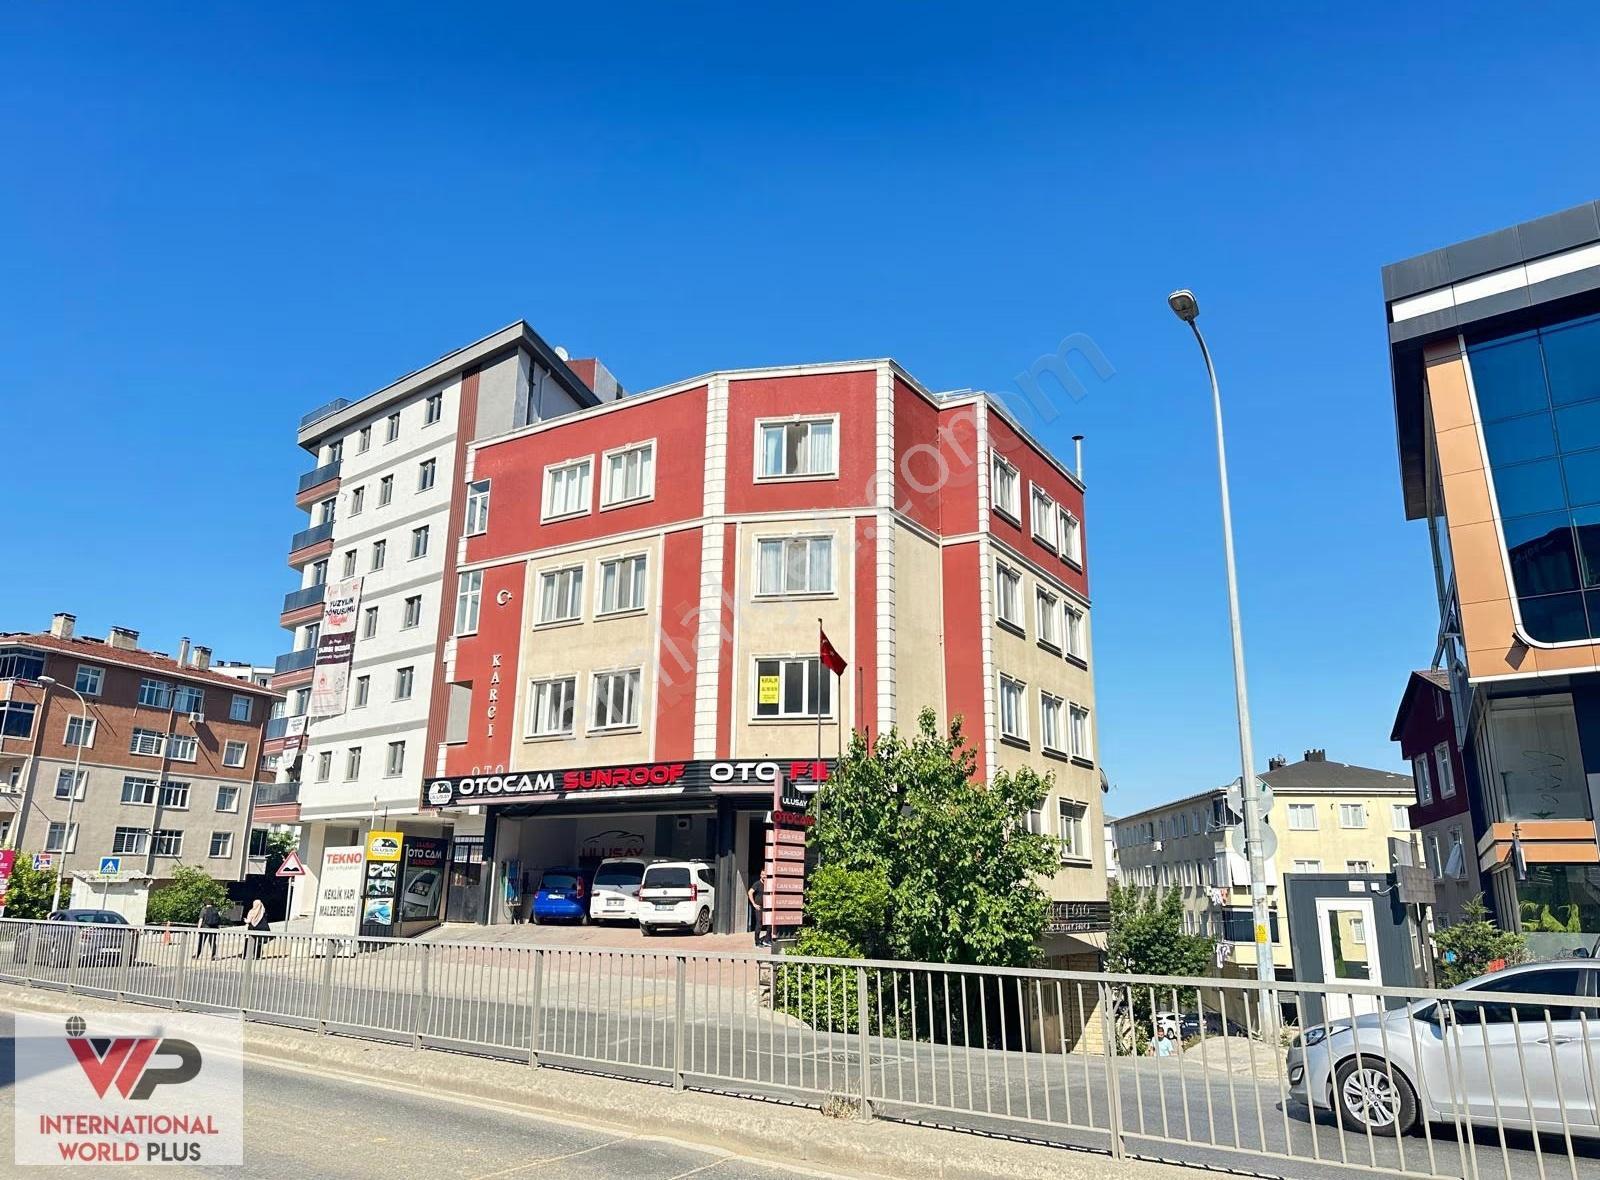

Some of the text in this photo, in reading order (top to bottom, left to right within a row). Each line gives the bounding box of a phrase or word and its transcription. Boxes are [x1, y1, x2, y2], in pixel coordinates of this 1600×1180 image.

[459, 773, 554, 795] OTOCAM
[563, 764, 685, 789] SUNROOF
[710, 762, 780, 781] OTO
[783, 797, 808, 806] ULUSAY
[327, 853, 362, 864] TEKNO
[408, 848, 442, 859] OTO CAM
